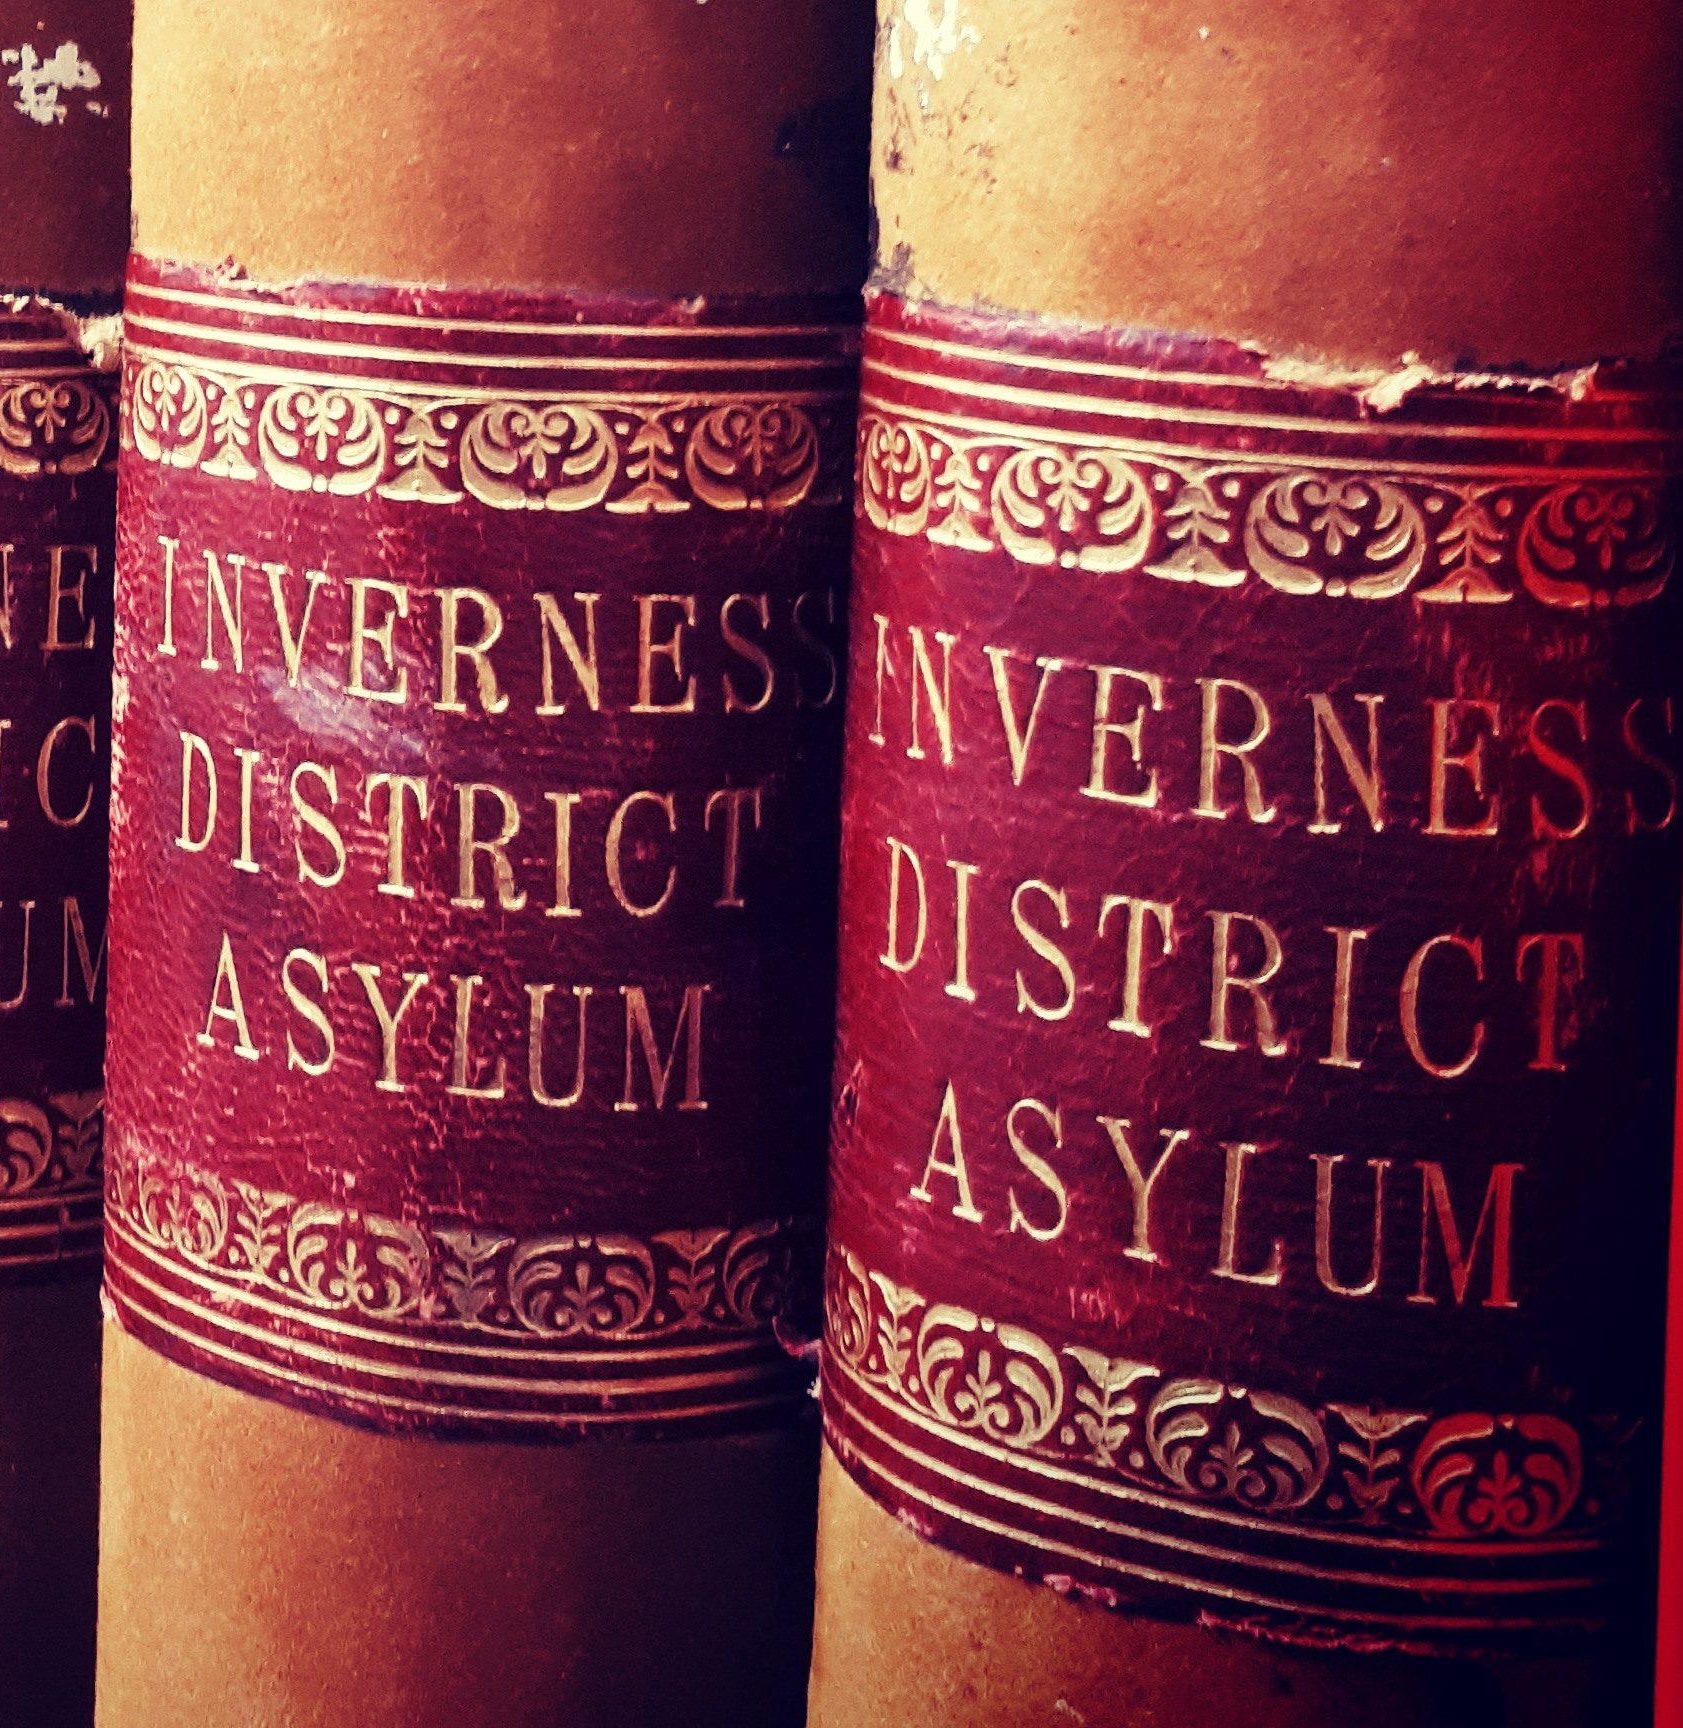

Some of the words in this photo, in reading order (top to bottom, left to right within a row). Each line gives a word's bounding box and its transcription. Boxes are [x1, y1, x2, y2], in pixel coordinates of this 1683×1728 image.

[157, 534, 838, 718] INVERNESS
[868, 611, 1677, 840] INVERNESS
[175, 729, 766, 919] DISTRICT
[197, 929, 714, 1115] ASYLUM
[878, 834, 1587, 1080] DISTRICT
[909, 1079, 1526, 1312] ASYLUM
